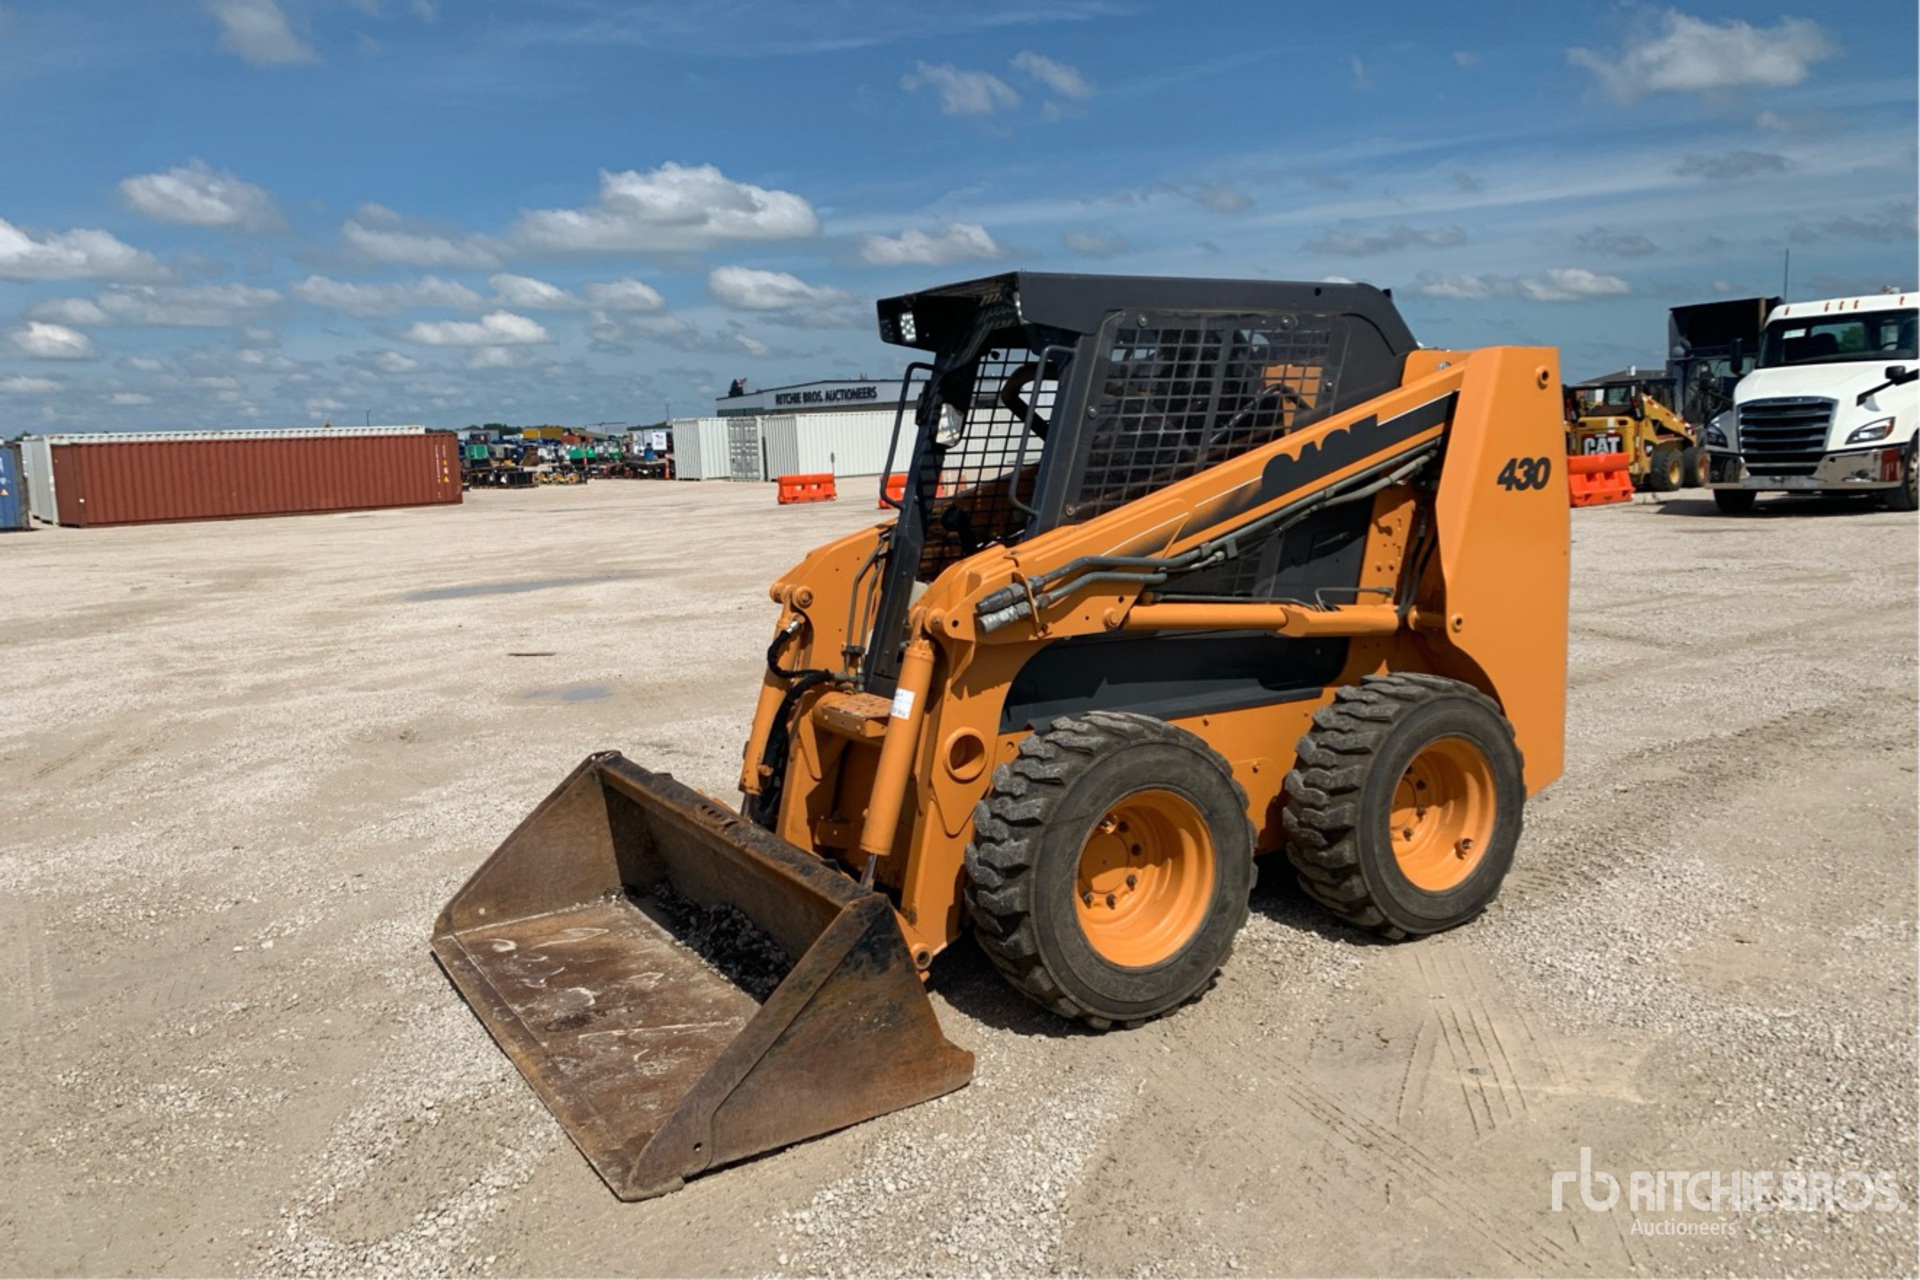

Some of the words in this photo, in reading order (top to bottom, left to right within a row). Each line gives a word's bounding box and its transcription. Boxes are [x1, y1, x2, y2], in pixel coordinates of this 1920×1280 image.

[776, 392, 801, 405] RITCHIE
[825, 386, 877, 402] AUCTIONEERS
[1583, 437, 1620, 456] CAT
[1497, 457, 1551, 491] 430
